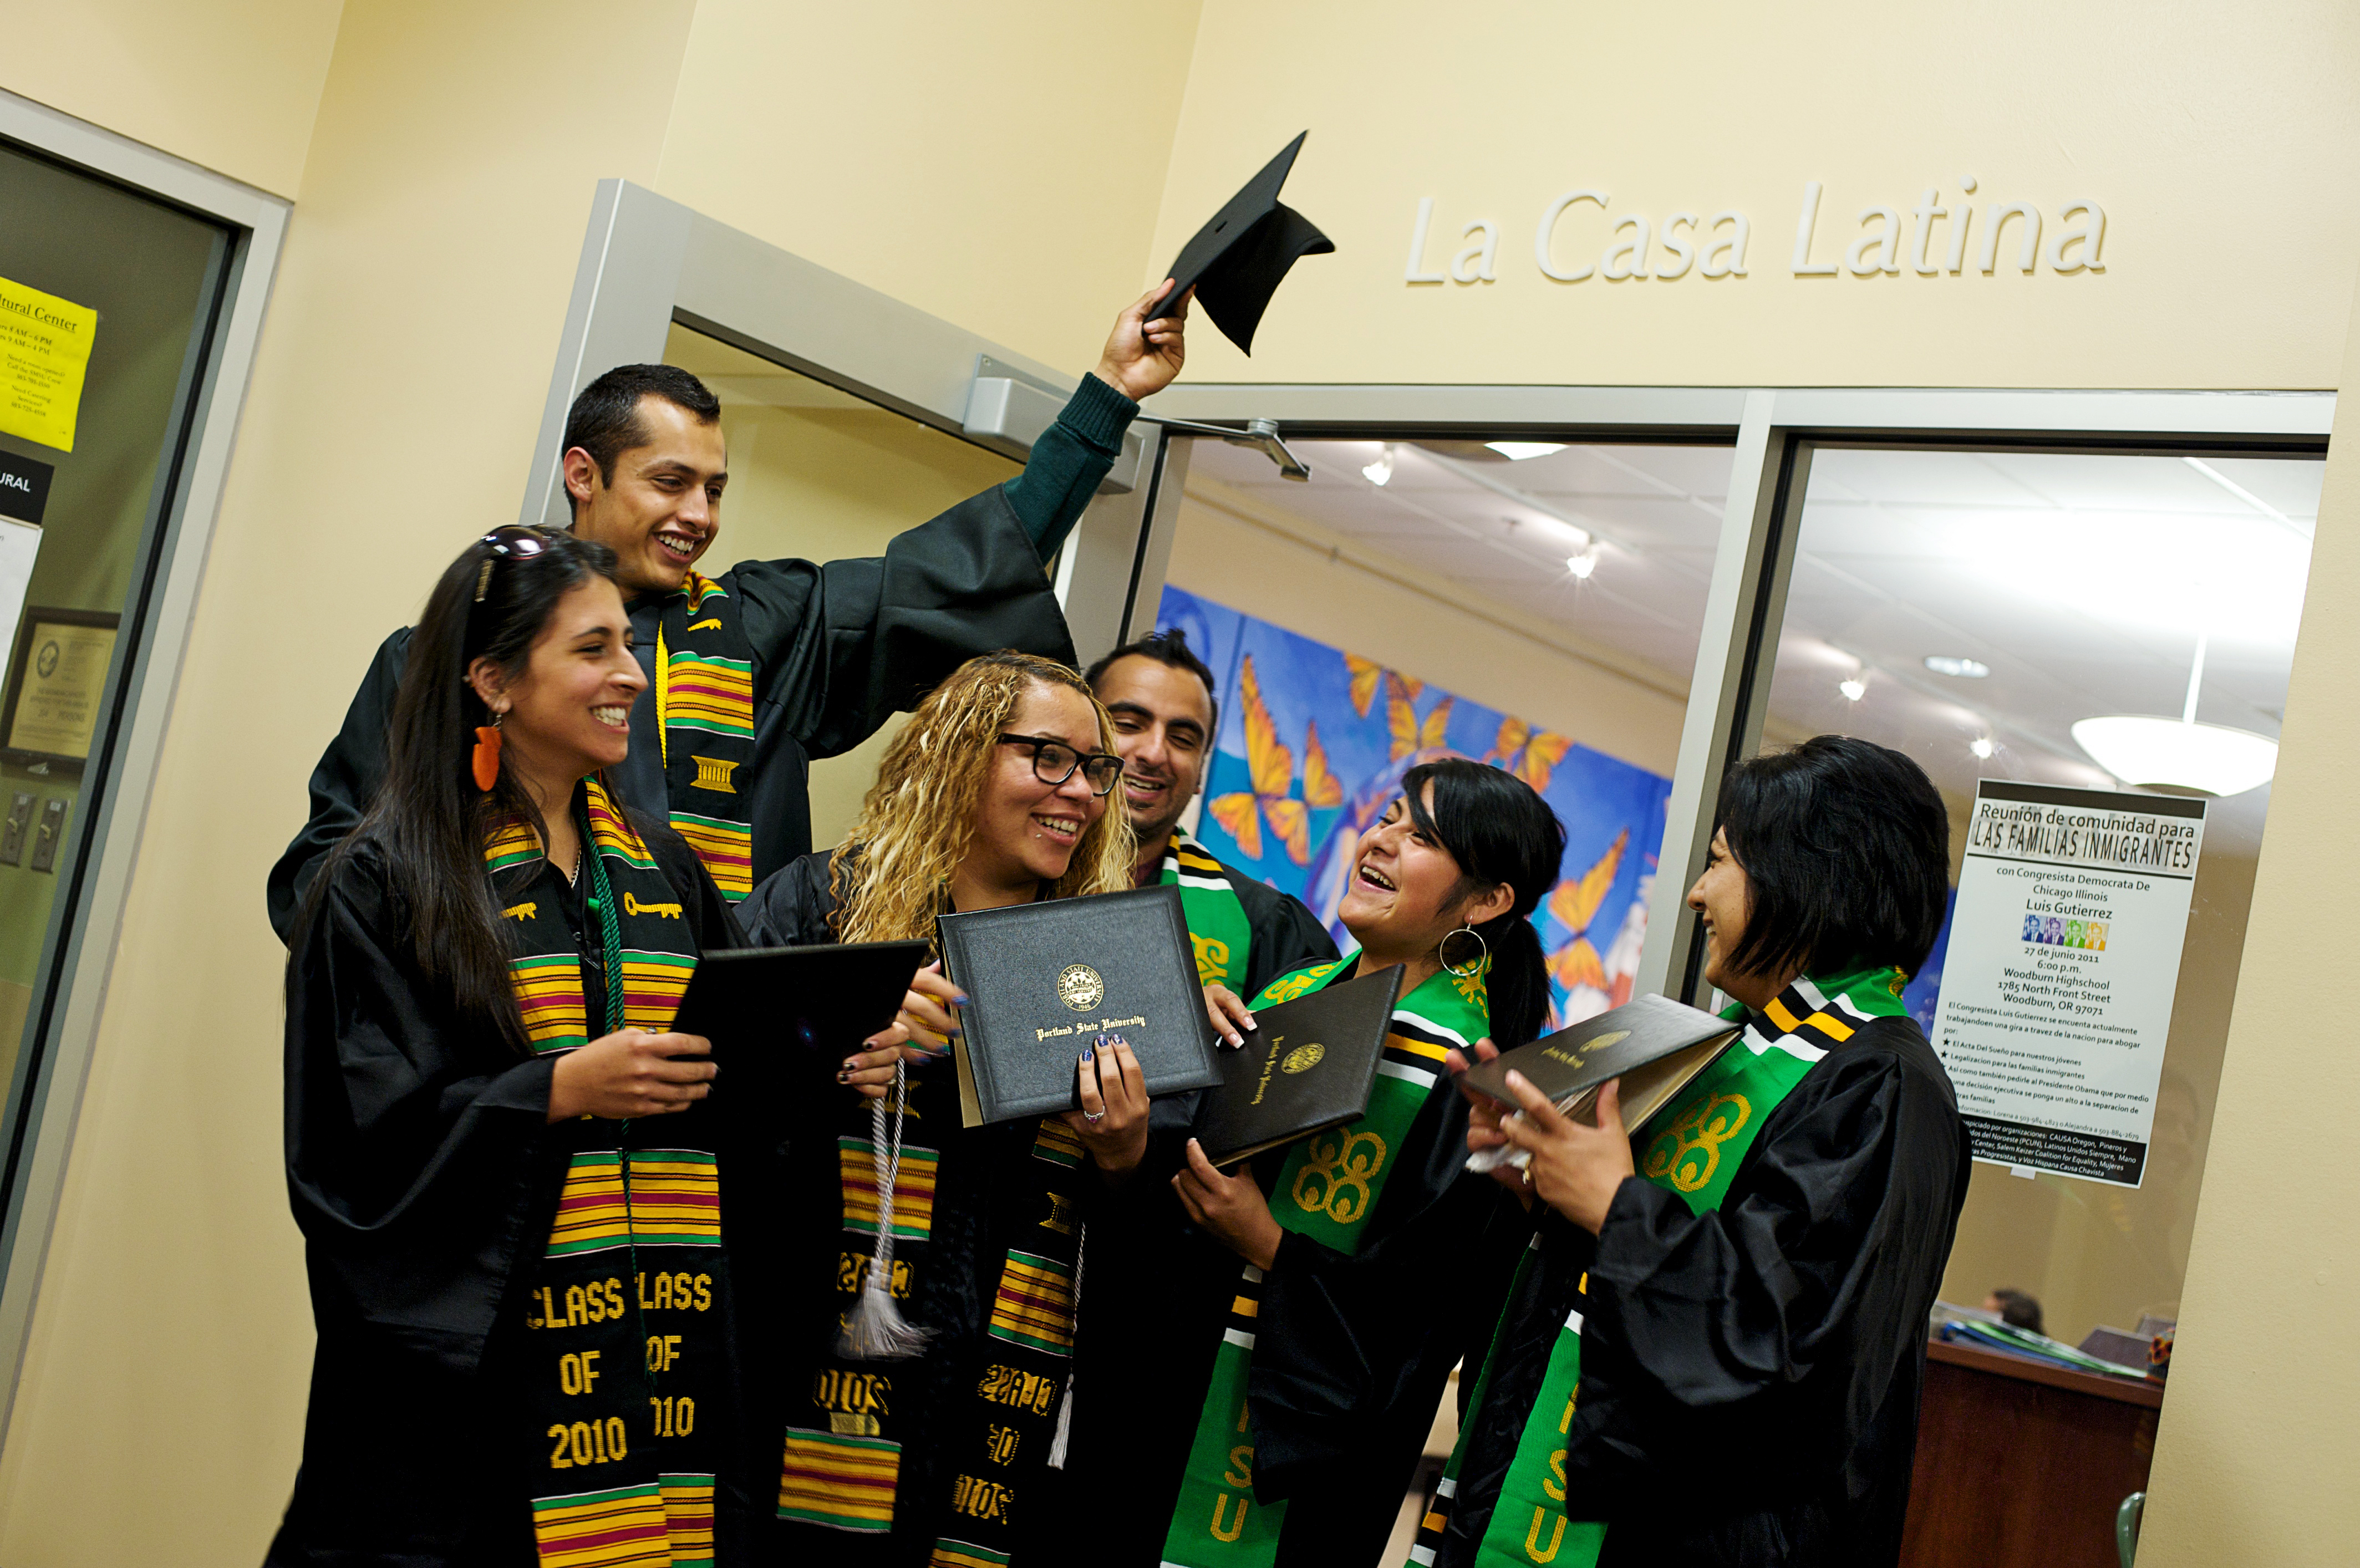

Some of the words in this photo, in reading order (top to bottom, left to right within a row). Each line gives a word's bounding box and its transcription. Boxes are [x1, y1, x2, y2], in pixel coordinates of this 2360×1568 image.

[1405, 196, 1499, 286] La
[1534, 189, 1751, 283] Casa
[1791, 175, 2108, 277] Latina
[34, 307, 77, 331] Center
[38, 347, 50, 355] PM
[39, 337, 53, 345] PM
[1981, 803, 2042, 823] Reunión
[2047, 810, 2064, 825] de
[2069, 816, 2155, 834] comunidad
[2159, 824, 2194, 842] para
[1975, 821, 2003, 849] LAS
[2008, 823, 2078, 857] FAMILIAS
[2083, 831, 2192, 868] INMIGRANTES
[1997, 867, 2014, 875] con
[2017, 867, 2074, 883] Congresista
[2078, 874, 2133, 889] Democrata
[2137, 880, 2150, 891] De
[2033, 884, 2072, 899] Chicago
[2076, 889, 2108, 902] Illinois
[2027, 898, 2051, 912] Luis
[2054, 902, 2112, 919] Gutierrez
[2025, 947, 2035, 956] 27
[2038, 946, 2049, 956] de
[2051, 948, 2075, 960] junio
[2078, 954, 2098, 963] 2011
[2038, 959, 2058, 970] 6:00
[2060, 964, 2081, 974] p.m.
[2005, 967, 2053, 982] Woodburn
[2056, 974, 2109, 990] Highschool
[1998, 981, 2020, 992] 1785
[2022, 982, 2050, 995] North
[2053, 986, 2078, 999] Front
[2081, 991, 2110, 1003] Street
[2003, 992, 2055, 1011] Woodburn,
[2059, 1000, 2073, 1011] OR
[2076, 1005, 2103, 1016] 97071
[1035, 1026, 1073, 1042] Portland
[1076, 1022, 1098, 1035] State
[1101, 1015, 1146, 1032] University
[634, 1271, 712, 1312] LASS
[646, 1335, 682, 1372] OF
[559, 1350, 601, 1396] OF
[547, 1416, 628, 1469] 2010
